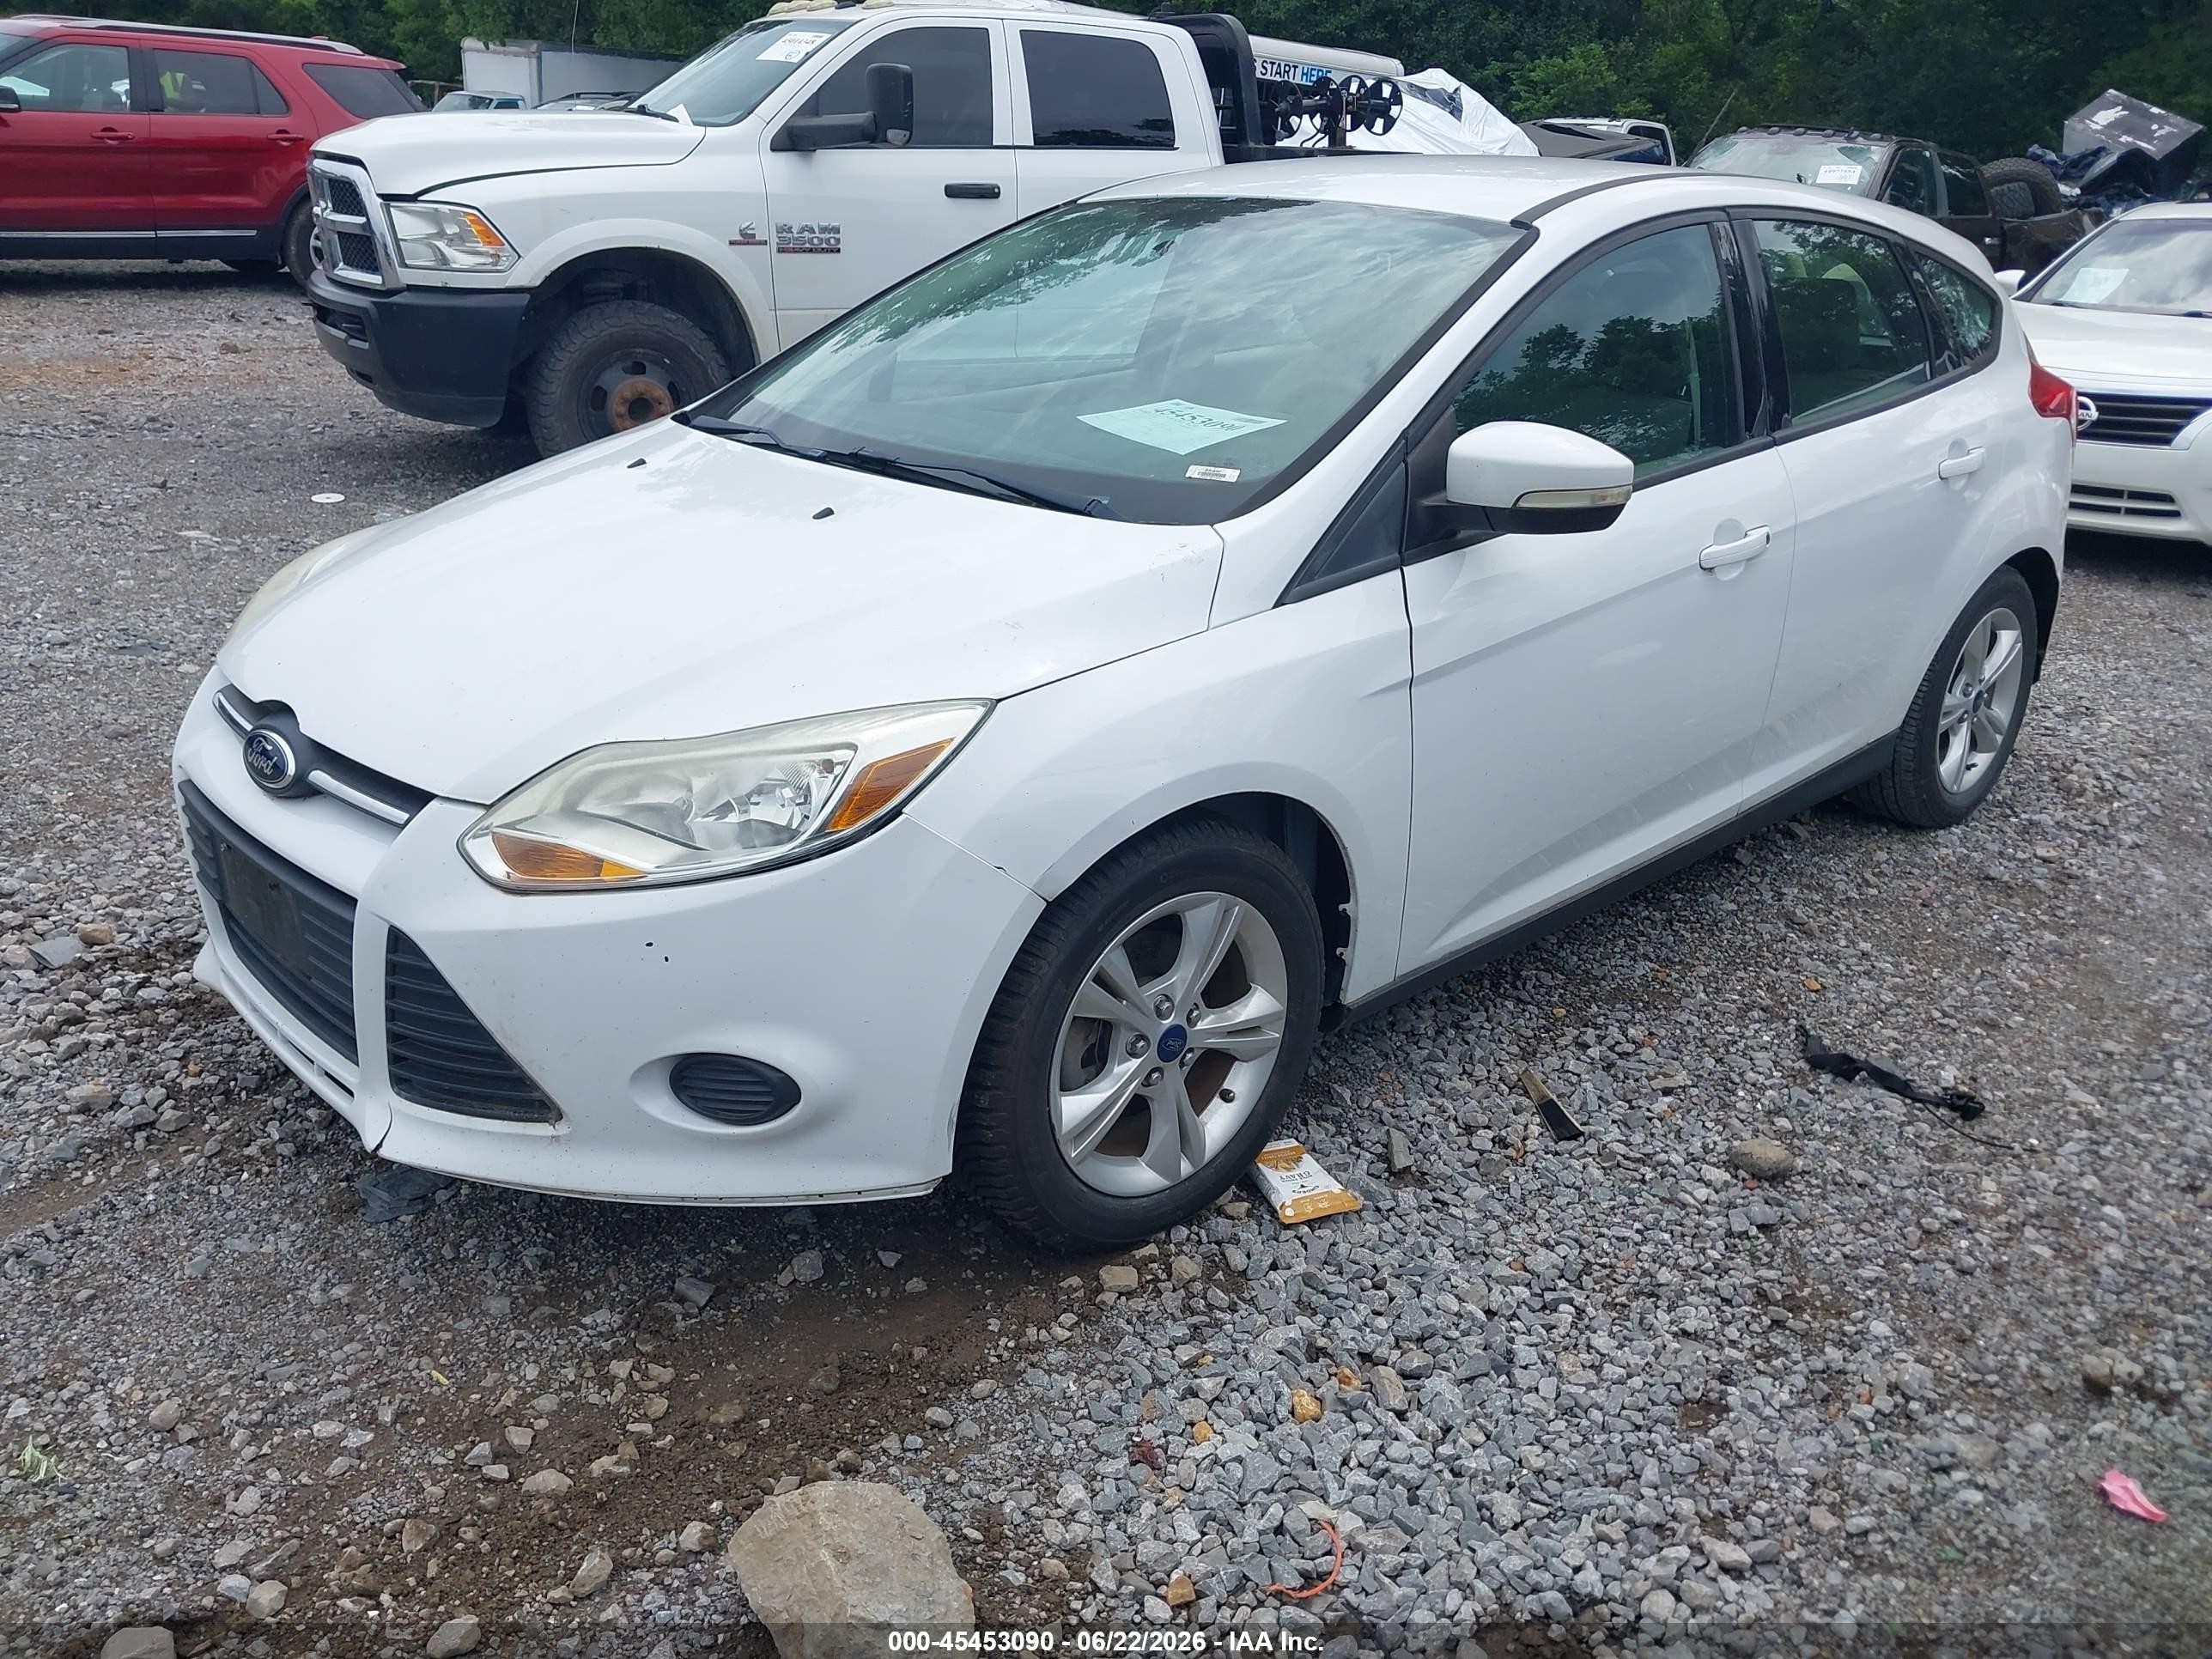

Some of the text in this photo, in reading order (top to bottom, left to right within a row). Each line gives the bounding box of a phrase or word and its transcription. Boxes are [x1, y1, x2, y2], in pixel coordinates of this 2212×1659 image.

[1260, 60, 1298, 80] START
[775, 222, 840, 234] RAM
[776, 234, 841, 246] 3500
[247, 737, 277, 775] Ford
[1279, 1170, 1310, 1180] GRAVY
